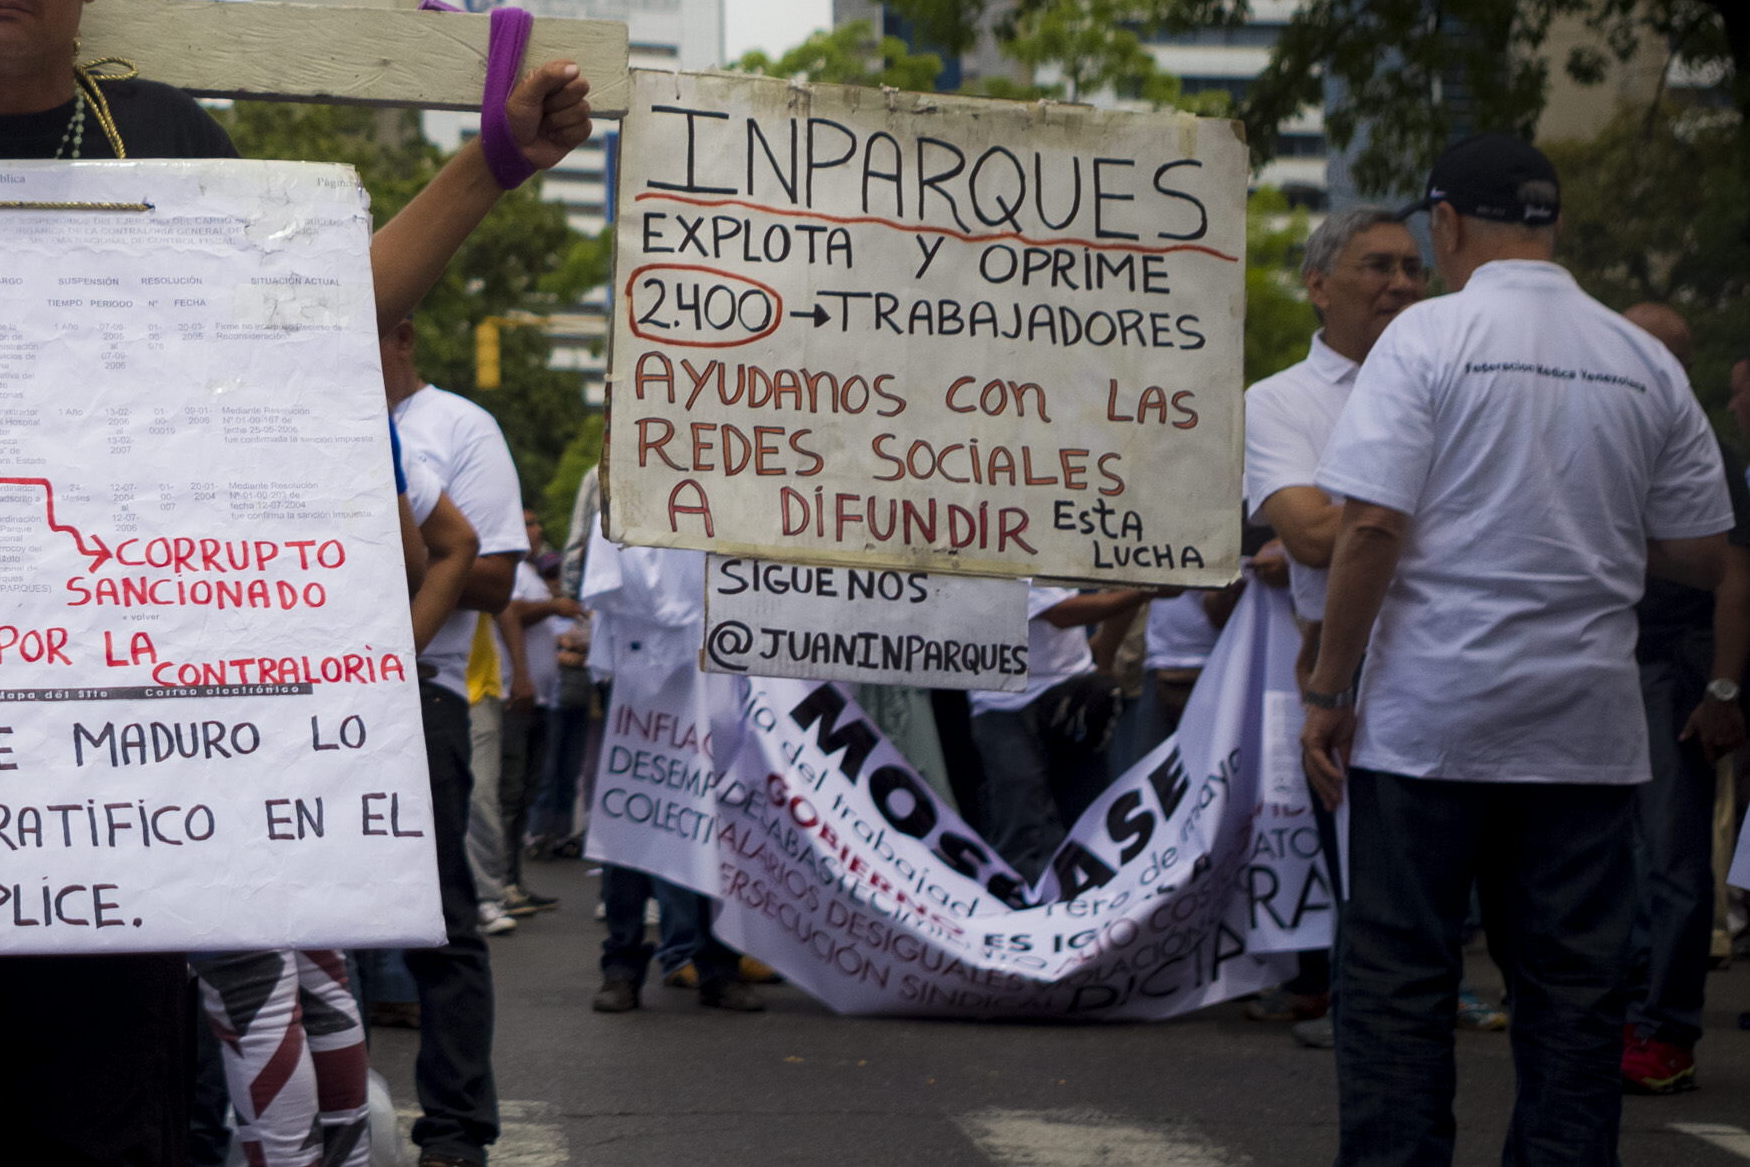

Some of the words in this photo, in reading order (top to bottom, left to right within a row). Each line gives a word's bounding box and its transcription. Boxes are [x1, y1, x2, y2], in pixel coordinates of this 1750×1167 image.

[647, 105, 1207, 240] INPARQUES
[643, 212, 852, 270] EXPLOTA
[915, 234, 945, 279] Y
[979, 245, 1170, 294] OPRIME
[58, 276, 119, 286] SUSPENSIÓN
[141, 276, 202, 285] RESOLUCIÓN
[250, 276, 301, 285] SITUACIÓN
[305, 278, 340, 286] ACTUAL
[90, 299, 133, 309] PERIODO
[174, 299, 206, 307] FECHA
[634, 278, 776, 332] 2.400
[816, 291, 1205, 350] TRABAJADORES
[1109, 378, 1199, 428] LAS
[635, 419, 823, 475] REDES
[874, 436, 1123, 494] SOCIALES
[669, 480, 712, 538] A
[781, 486, 1038, 555] DIFUNDIR
[116, 537, 345, 573] CORRUPTO
[1093, 540, 1205, 570] LUCHA
[67, 576, 326, 610] SANCIONADO
[718, 559, 929, 603] SIGUENOS
[104, 631, 157, 667] LA
[707, 620, 1028, 675] @JUANINPARQUES
[145, 687, 199, 698] Correo
[73, 721, 260, 767] MADURO
[311, 715, 366, 751] LO
[265, 797, 324, 840] EN
[362, 792, 424, 837] EL
[781, 739, 828, 792] del
[1139, 845, 1179, 888] de
